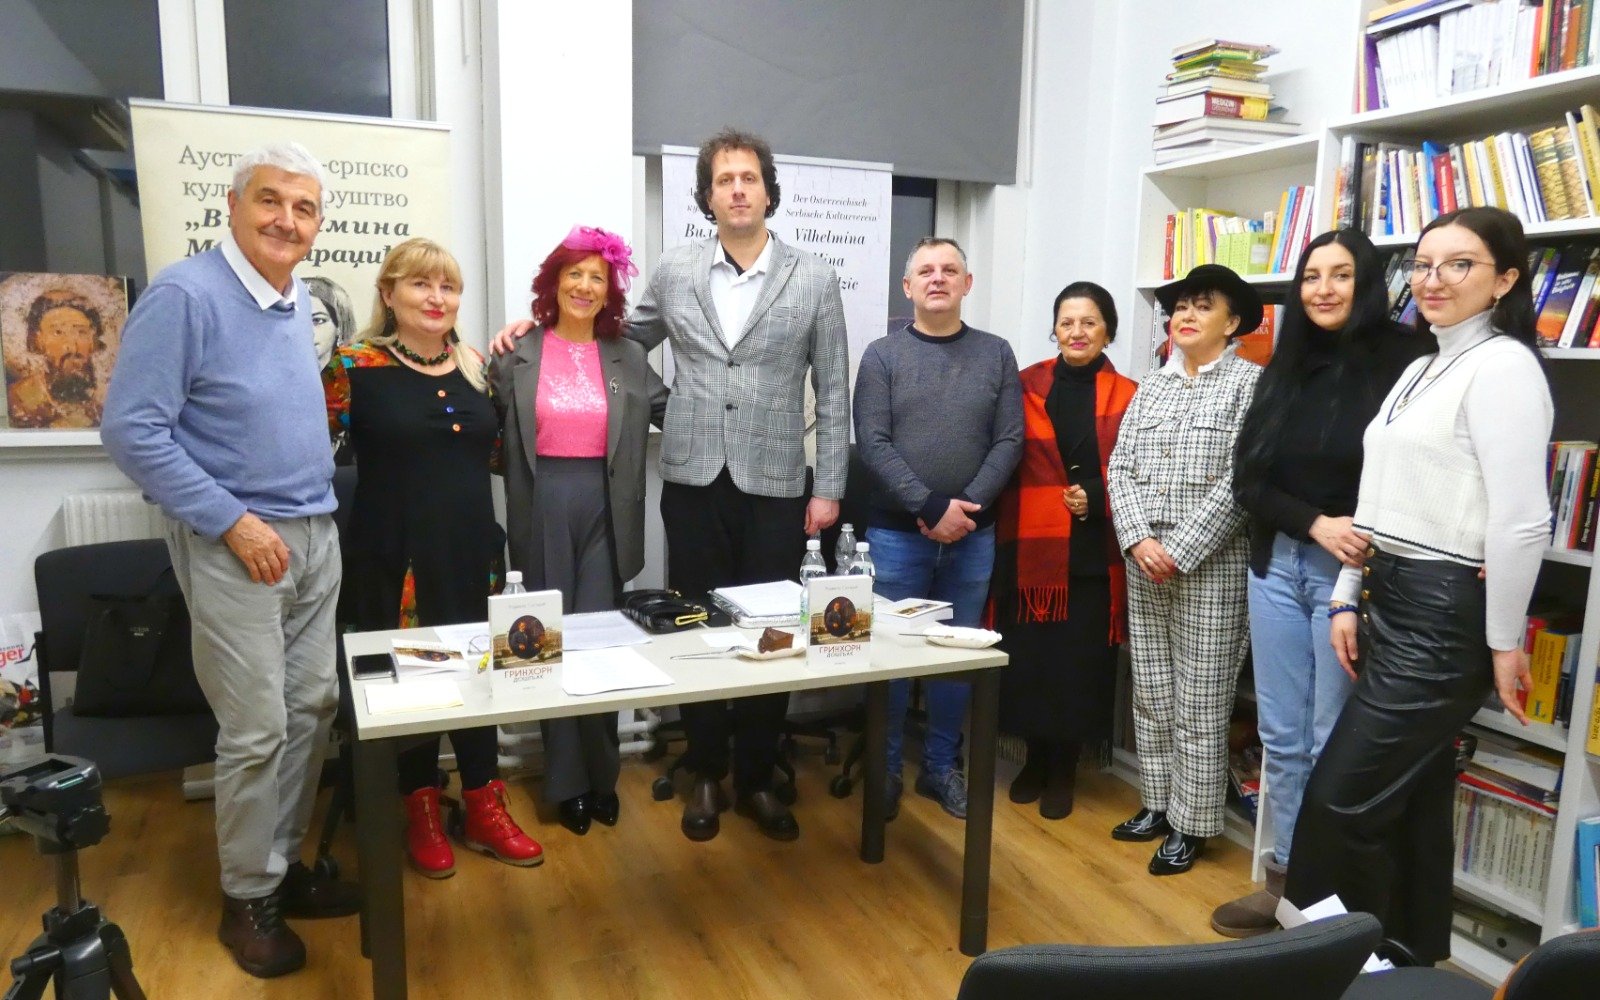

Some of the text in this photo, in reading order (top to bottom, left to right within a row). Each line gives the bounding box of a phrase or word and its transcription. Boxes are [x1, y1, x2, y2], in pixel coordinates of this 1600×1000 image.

[793, 193, 808, 204] Der
[786, 209, 877, 222] Serbische Kulturverein
[796, 228, 865, 245] Vilhelmina
[819, 644, 861, 654] ГРИНХОРН
[504, 666, 552, 679] ГРИНХОРН
